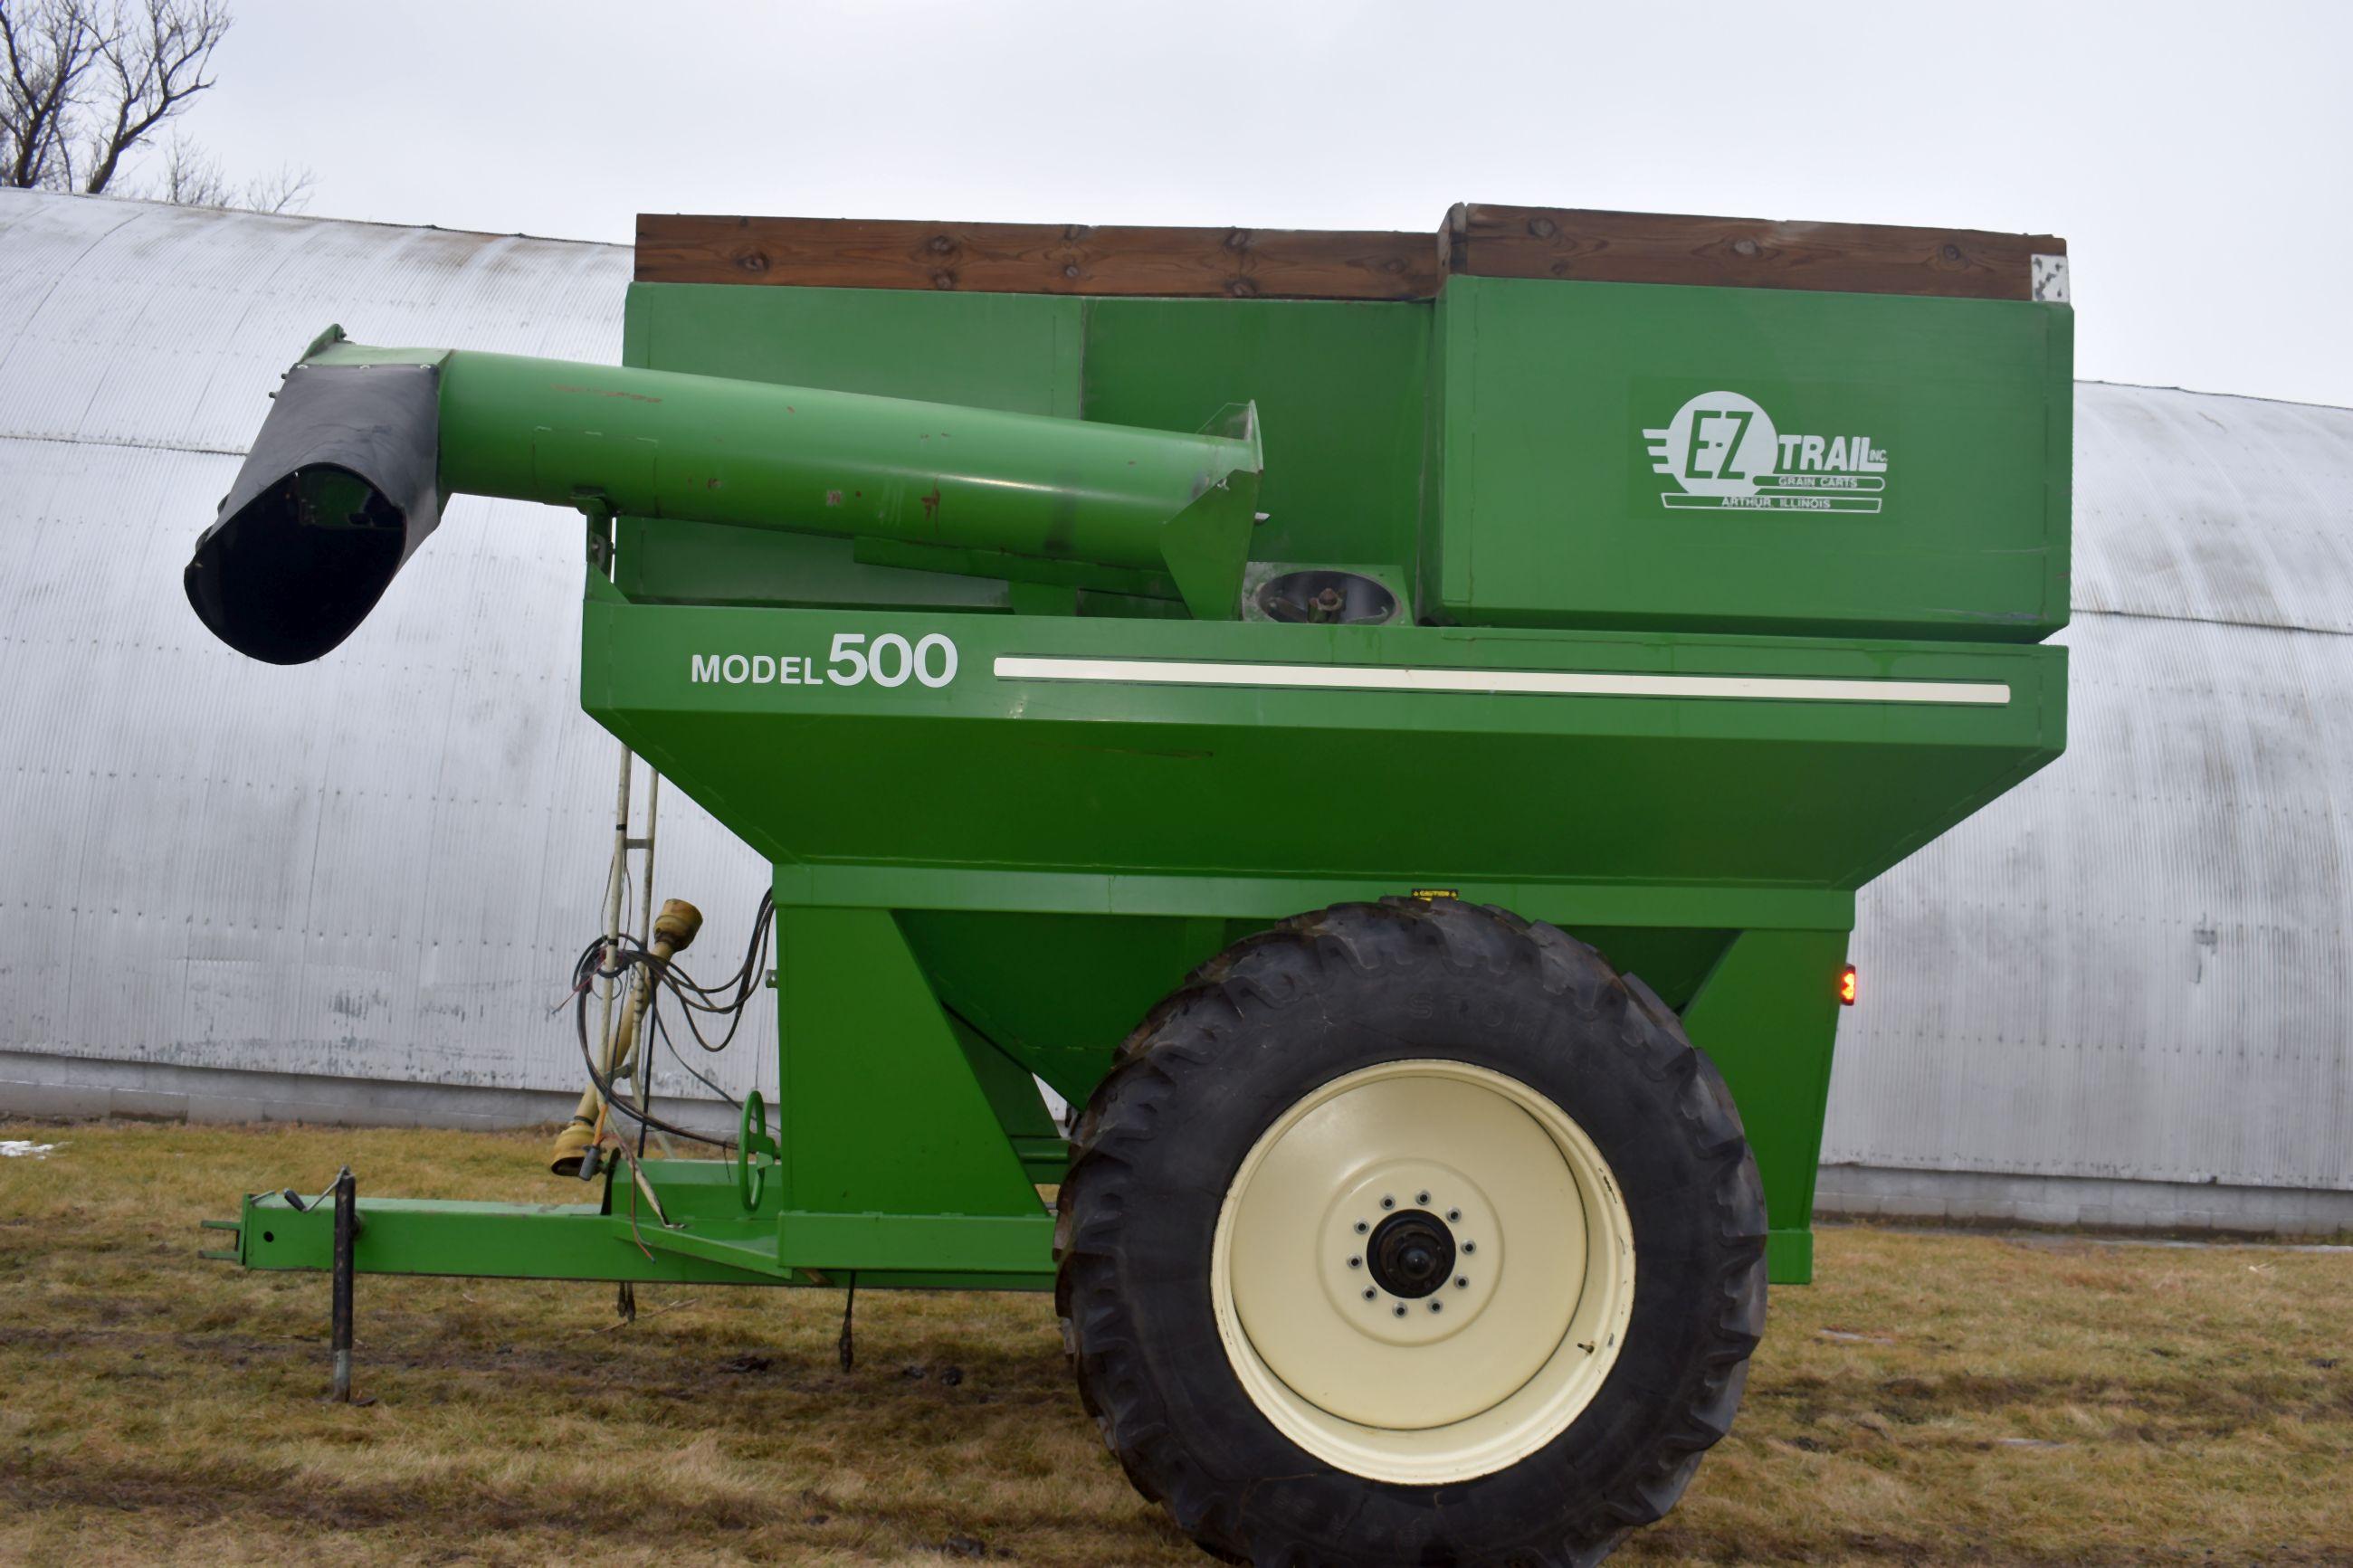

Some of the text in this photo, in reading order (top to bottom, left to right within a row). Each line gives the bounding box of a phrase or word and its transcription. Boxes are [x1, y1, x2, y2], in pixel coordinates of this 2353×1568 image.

[1778, 434, 1887, 472] TRAIL
[1778, 477, 1858, 489] GRAIN CARTS
[1779, 499, 1831, 509] ILLINOIS
[691, 633, 958, 688] MODEL 500
